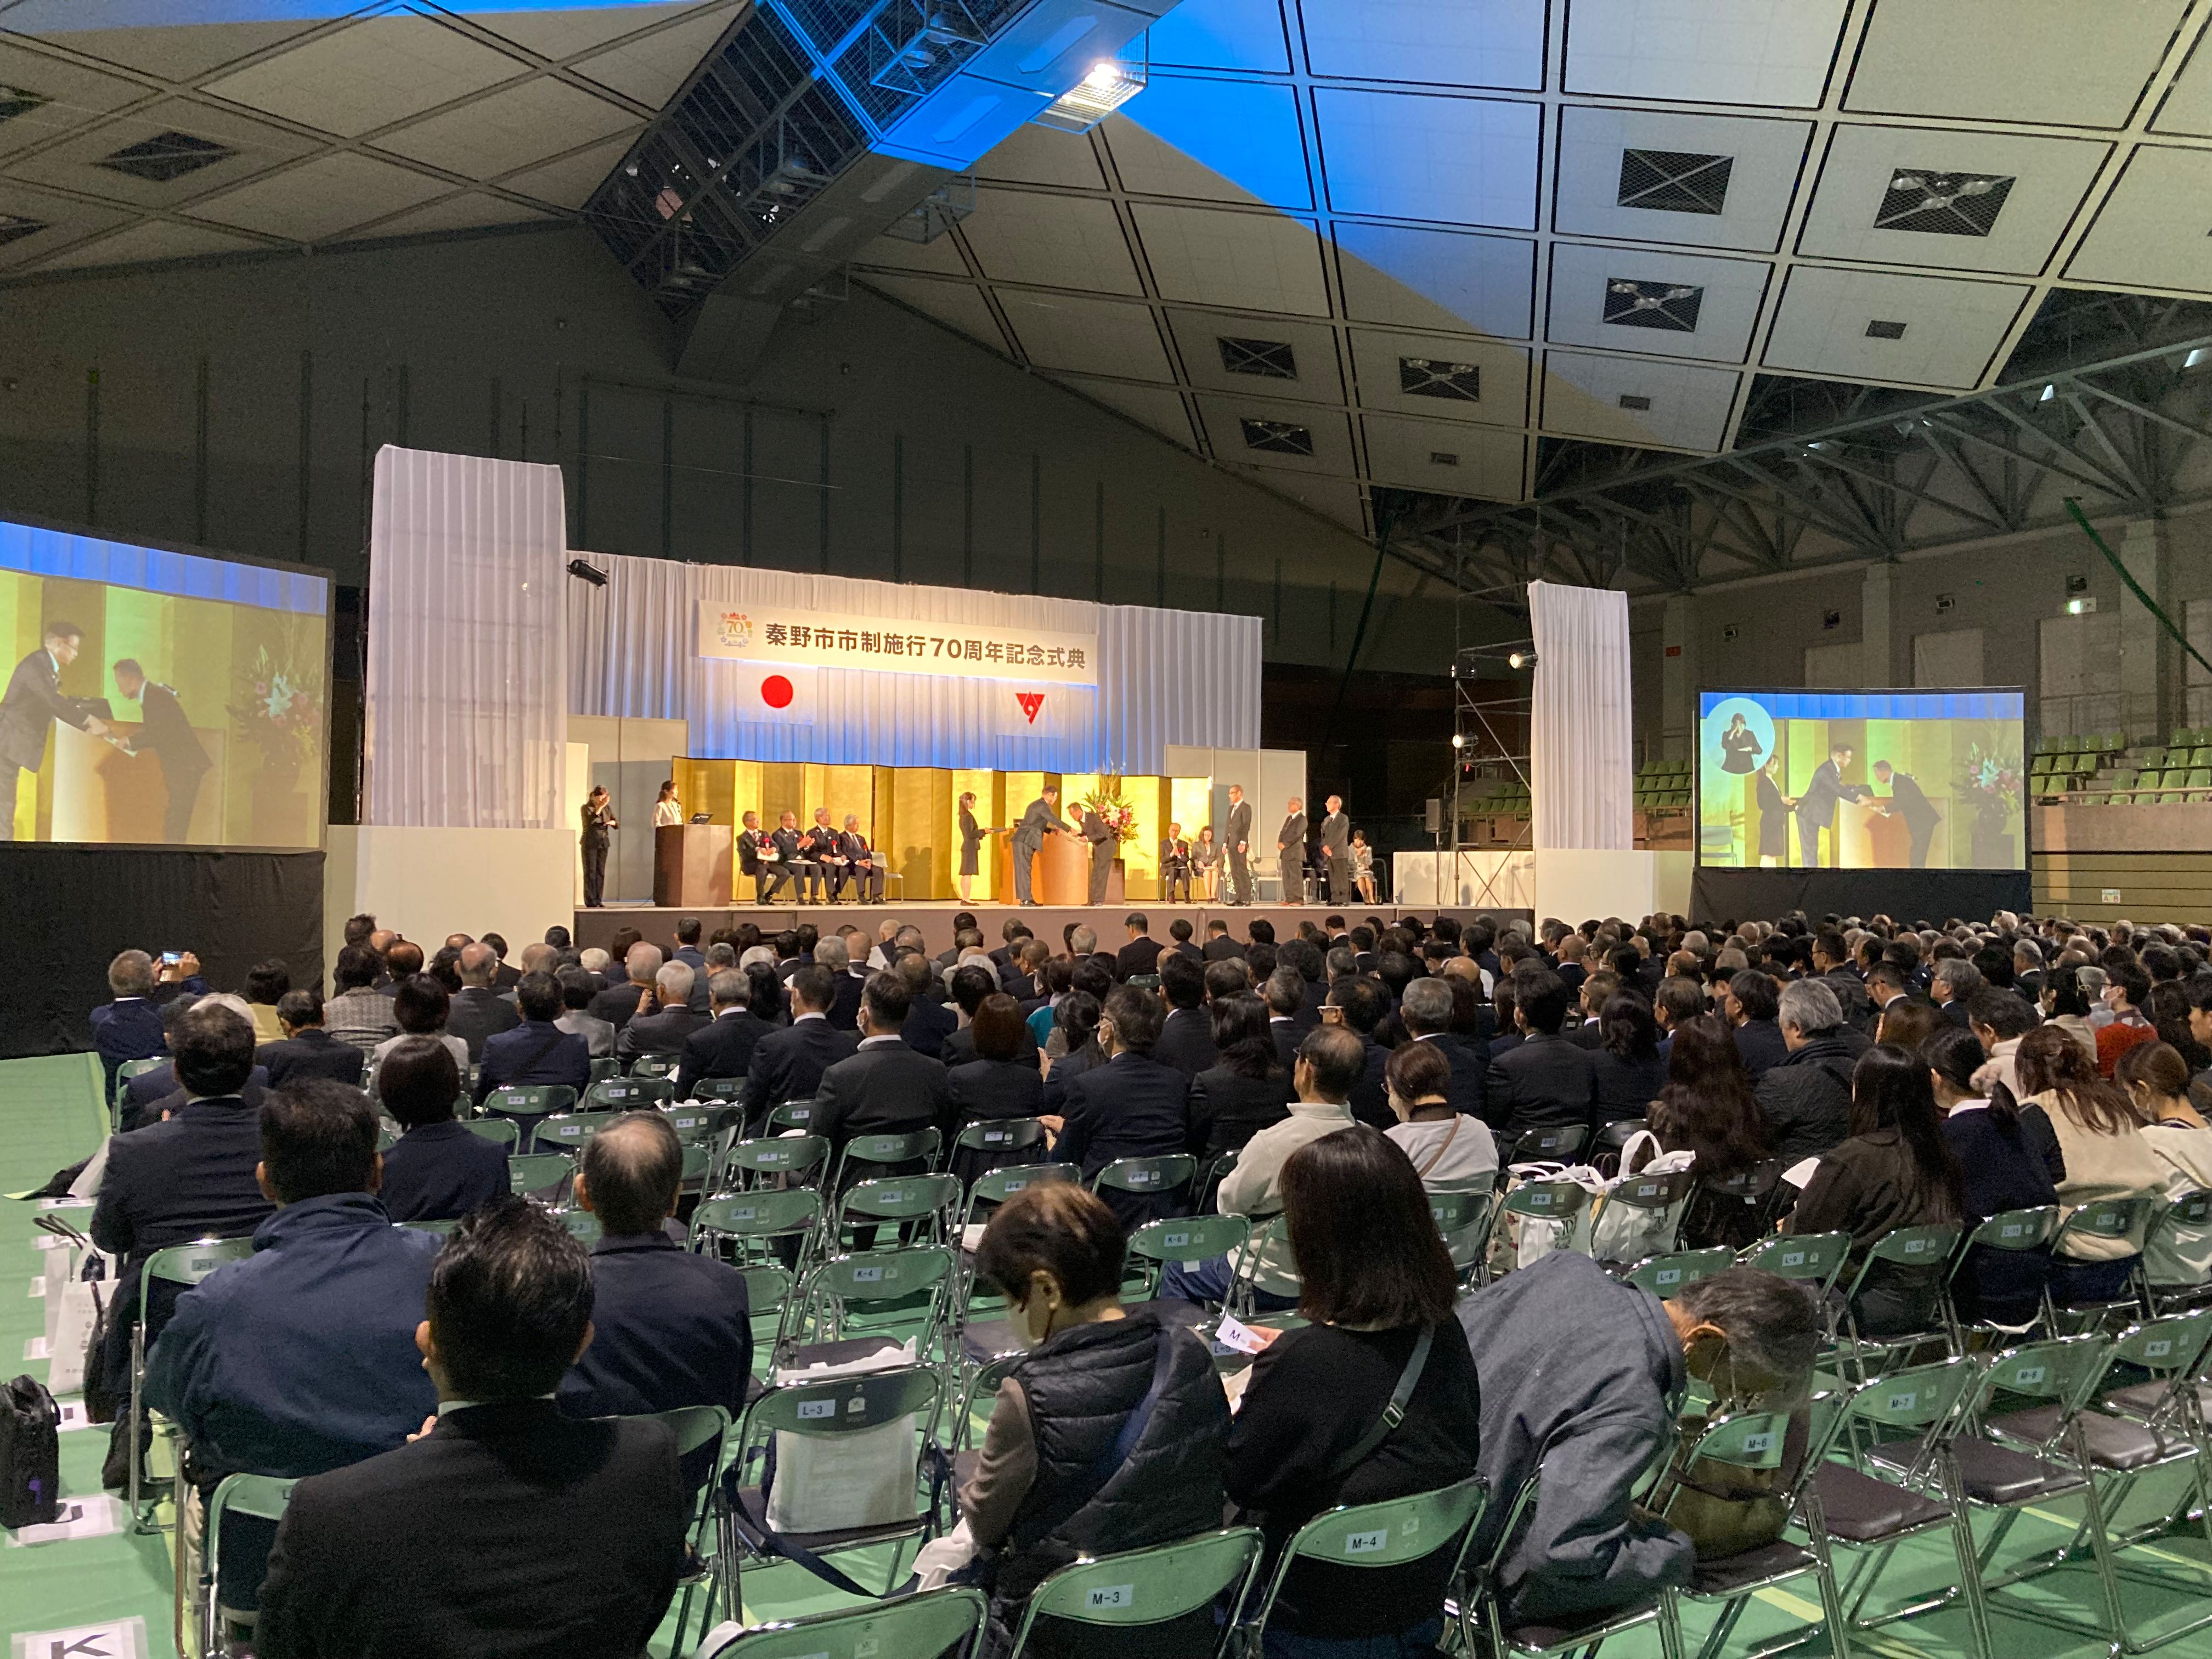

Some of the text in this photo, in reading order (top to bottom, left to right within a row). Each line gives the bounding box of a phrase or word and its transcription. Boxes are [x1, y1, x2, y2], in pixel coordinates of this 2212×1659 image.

[766, 623, 1085, 669] 秦野市市制施行70周年記念式典
[857, 1269, 872, 1278] K-4
[1660, 1272, 1673, 1280] L-8
[1891, 1397, 1908, 1409] M-7
[803, 1404, 823, 1415] L-3
[1748, 1438, 1768, 1449] M-6
[1352, 1536, 1377, 1550] M-4
[1092, 1592, 1120, 1605] M-3
